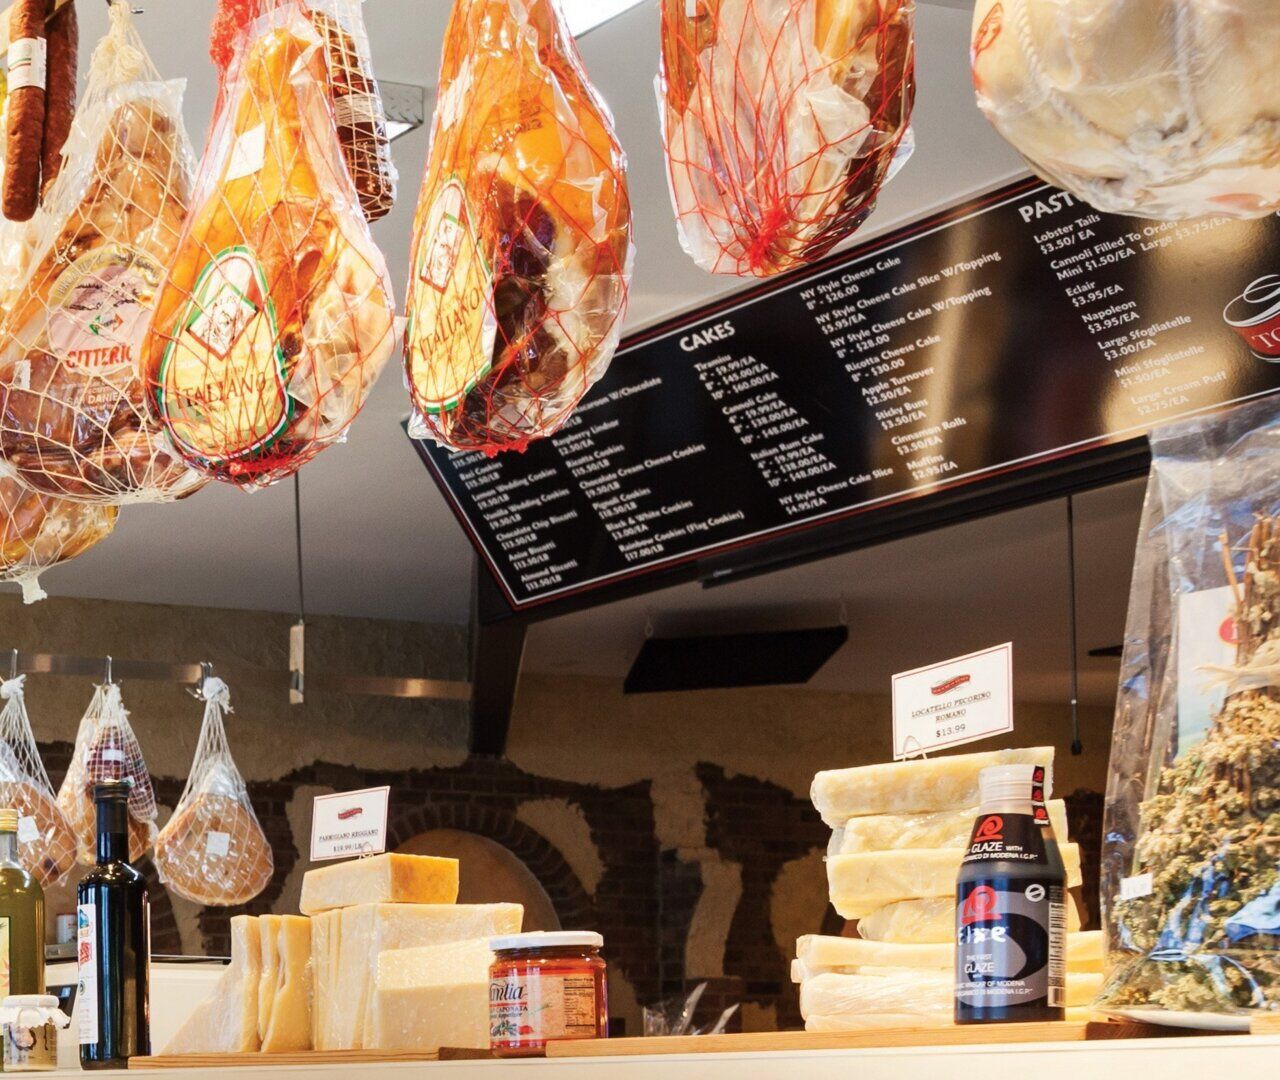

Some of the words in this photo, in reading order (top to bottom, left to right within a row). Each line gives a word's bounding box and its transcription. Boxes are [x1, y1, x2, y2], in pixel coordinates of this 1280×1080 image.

[1018, 190, 1077, 223] PAST
[1033, 222, 1073, 245] Lobster
[1075, 213, 1101, 228] Tails
[1040, 234, 1075, 255] $3.50/
[1079, 229, 1096, 241] EA
[1050, 249, 1093, 270] Cannoli
[1094, 238, 1125, 254] Filled
[1126, 233, 1140, 242] To
[1143, 221, 1178, 236] Order
[1056, 265, 1083, 281] Mini
[1085, 247, 1136, 272] $1.50/EA
[1140, 235, 1173, 252] Large
[1175, 217, 1232, 241] $3.75/EA
[800, 287, 815, 300] NY
[817, 280, 840, 294] Style
[842, 267, 875, 285] Cheese
[876, 257, 901, 271] Cake
[815, 312, 831, 325] NY
[832, 304, 856, 319] Style
[857, 292, 891, 309] Cheese
[892, 282, 917, 296] Cake
[917, 273, 940, 287] Slice
[941, 251, 1002, 278] W/Topping
[1065, 280, 1096, 297] Eclair
[826, 284, 859, 303] $26.00
[1072, 284, 1124, 308] $3.95/EA
[830, 337, 846, 349] NY
[847, 328, 871, 342] Style
[872, 316, 906, 334] Cheese
[907, 306, 932, 321] Cake
[932, 285, 992, 312] W/Topping
[1081, 300, 1137, 324] Napoleon
[1088, 311, 1139, 334] $3.95/EA
[822, 313, 867, 335] $5.95/EA
[1097, 334, 1128, 350] Large
[1129, 314, 1192, 340] Sfogliatelle
[679, 320, 735, 352] CAKES
[856, 334, 890, 352] $28.00
[845, 356, 880, 372] Ricotta
[881, 344, 915, 360] Cheese
[916, 334, 941, 348] Cake
[1104, 338, 1156, 361] $3.00/EA
[1115, 364, 1141, 378] Mini
[1142, 344, 1205, 370] Sfogliatelle
[716, 355, 756, 376] $9.99/EA
[871, 358, 905, 377] $30.00
[608, 377, 662, 400] W/Chocolate
[861, 381, 889, 397] Apple
[890, 367, 936, 386] Turnover
[1131, 389, 1161, 405] Large
[1163, 379, 1201, 397] Cream
[1203, 370, 1228, 385] Puff
[722, 398, 755, 415] Cannoli
[756, 392, 778, 403] Cake
[866, 386, 911, 406] $2.50/EA
[875, 404, 903, 421] Sticky
[904, 399, 928, 411] Buns
[881, 410, 927, 431] $3.50/EA
[891, 425, 941, 445] Cinnamon
[942, 417, 967, 430] Rolls
[594, 444, 625, 458] Cookies
[750, 447, 779, 461] Italian
[779, 441, 801, 451] Rum
[802, 433, 824, 444] Cake
[897, 435, 943, 456] $3.50/EA
[579, 472, 617, 489] Chocolate
[618, 465, 644, 477] Cream
[644, 454, 672, 468] Cheese
[672, 443, 706, 458] Cookies
[906, 454, 944, 470] Muffins
[912, 461, 958, 481] $2.95/EA
[528, 468, 557, 482] Cookies
[541, 488, 570, 502] Cookies
[619, 487, 651, 502] Cookies
[779, 495, 792, 506] NY
[794, 490, 816, 501] Style
[816, 481, 848, 495] Cheese
[849, 474, 871, 485] Cake
[872, 468, 894, 478] Slice
[605, 520, 627, 532] Black
[635, 510, 661, 522] White
[661, 500, 693, 514] Cookies
[786, 498, 827, 515] $4.95/EA
[655, 528, 686, 542] Cookies
[708, 510, 745, 526] Cookies)
[912, 701, 952, 718] LOCATELLO
[954, 692, 991, 706] PECORINO
[936, 709, 966, 722] ROMANO
[936, 724, 966, 738] $13.99
[971, 842, 1003, 853] GLAZE
[964, 962, 994, 974] GLAZE
